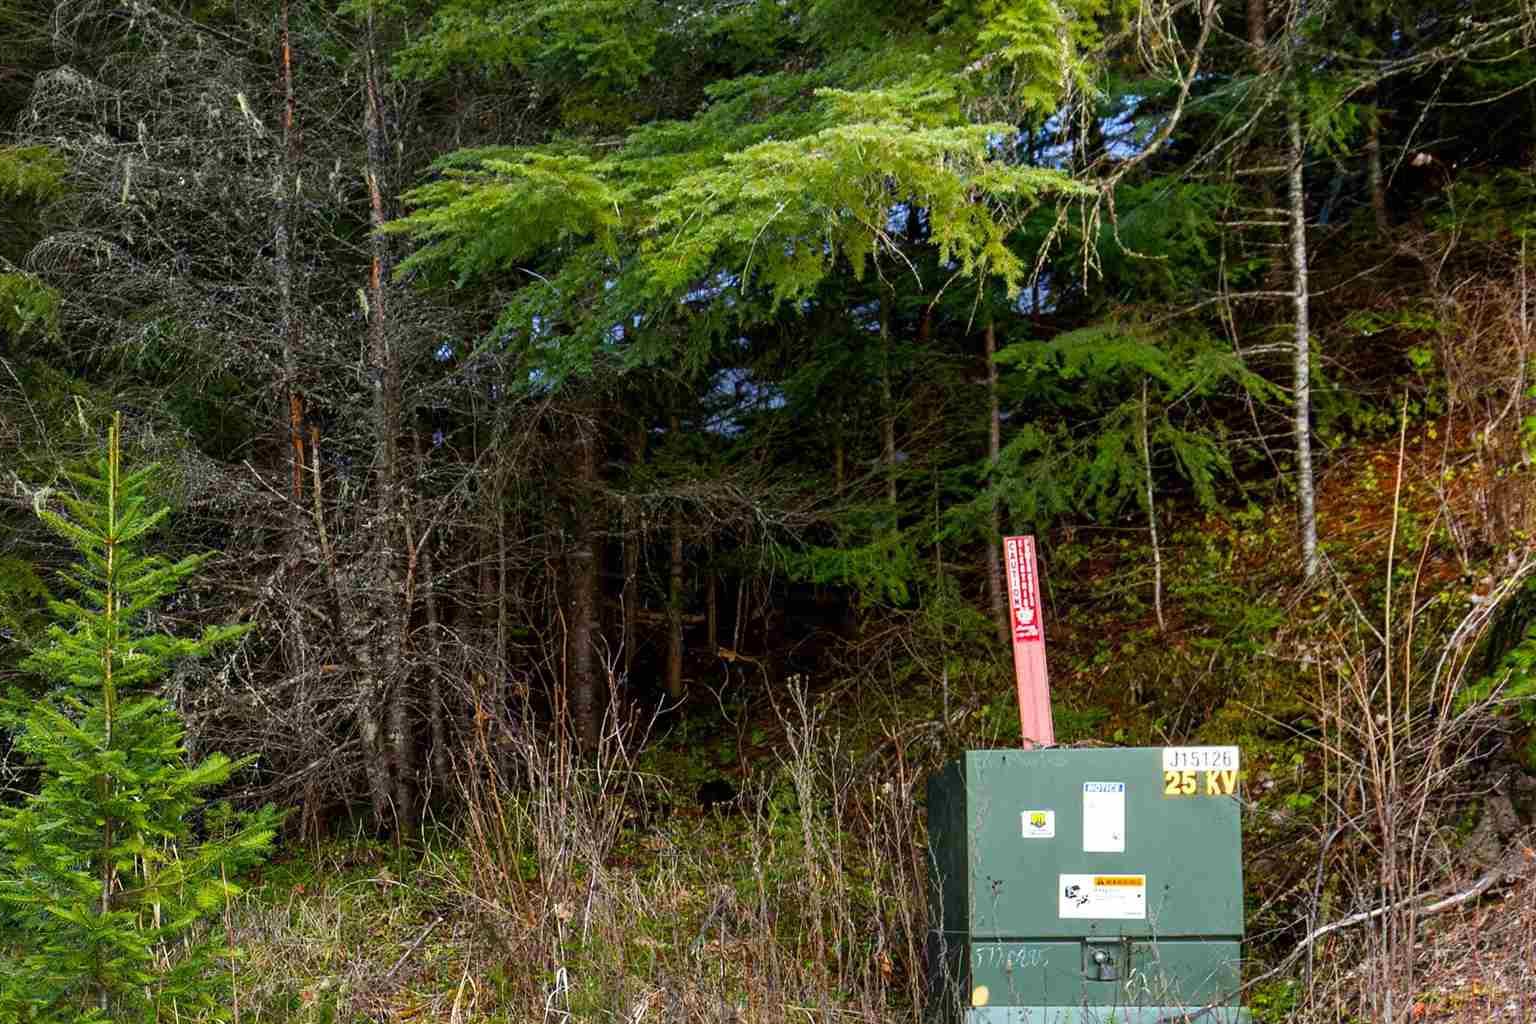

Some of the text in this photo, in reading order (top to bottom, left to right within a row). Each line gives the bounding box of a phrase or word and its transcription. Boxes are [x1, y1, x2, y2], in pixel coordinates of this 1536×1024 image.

[1008, 542, 1020, 606] CAUTION
[1169, 751, 1232, 767] J15126
[1165, 769, 1237, 795] 25 KV
